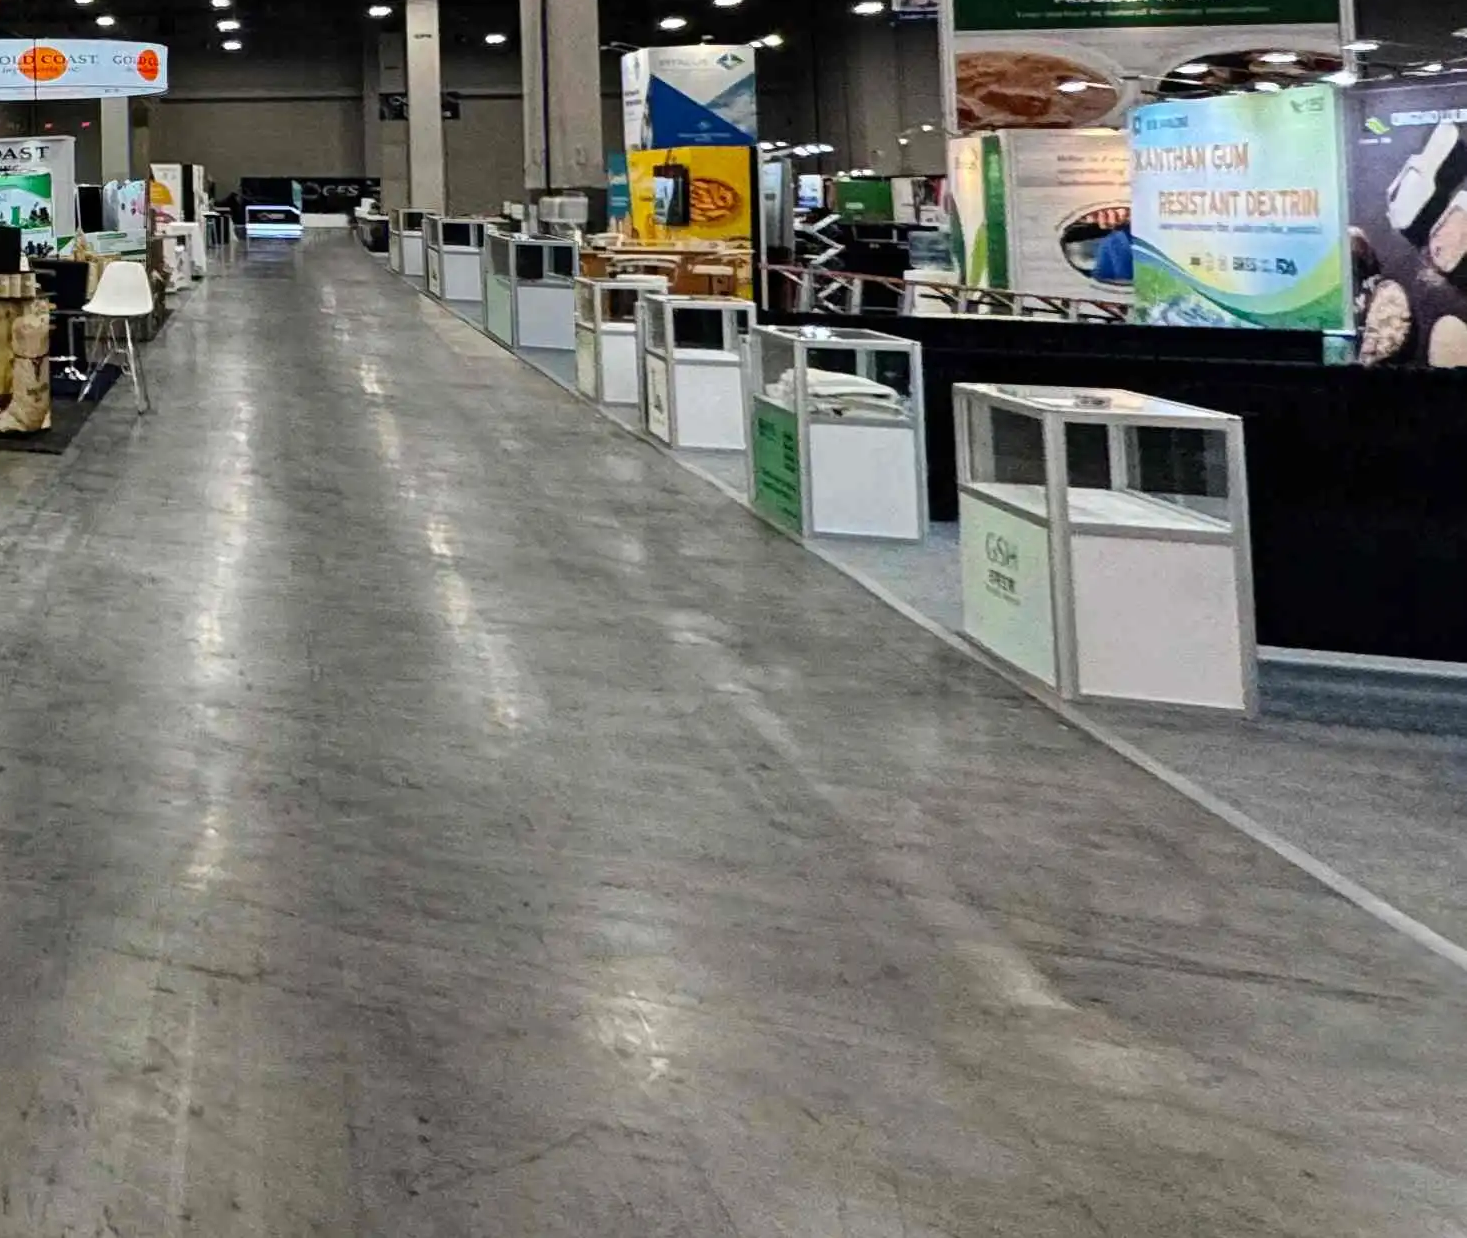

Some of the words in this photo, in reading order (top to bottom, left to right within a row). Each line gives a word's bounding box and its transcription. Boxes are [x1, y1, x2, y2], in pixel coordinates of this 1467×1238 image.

[40, 53, 100, 66] COAST
[1133, 145, 1207, 172] XANTHAN
[1211, 142, 1249, 172] GUM
[1158, 190, 1240, 218] RESISTANT
[1245, 189, 1320, 218] DEXTRIN
